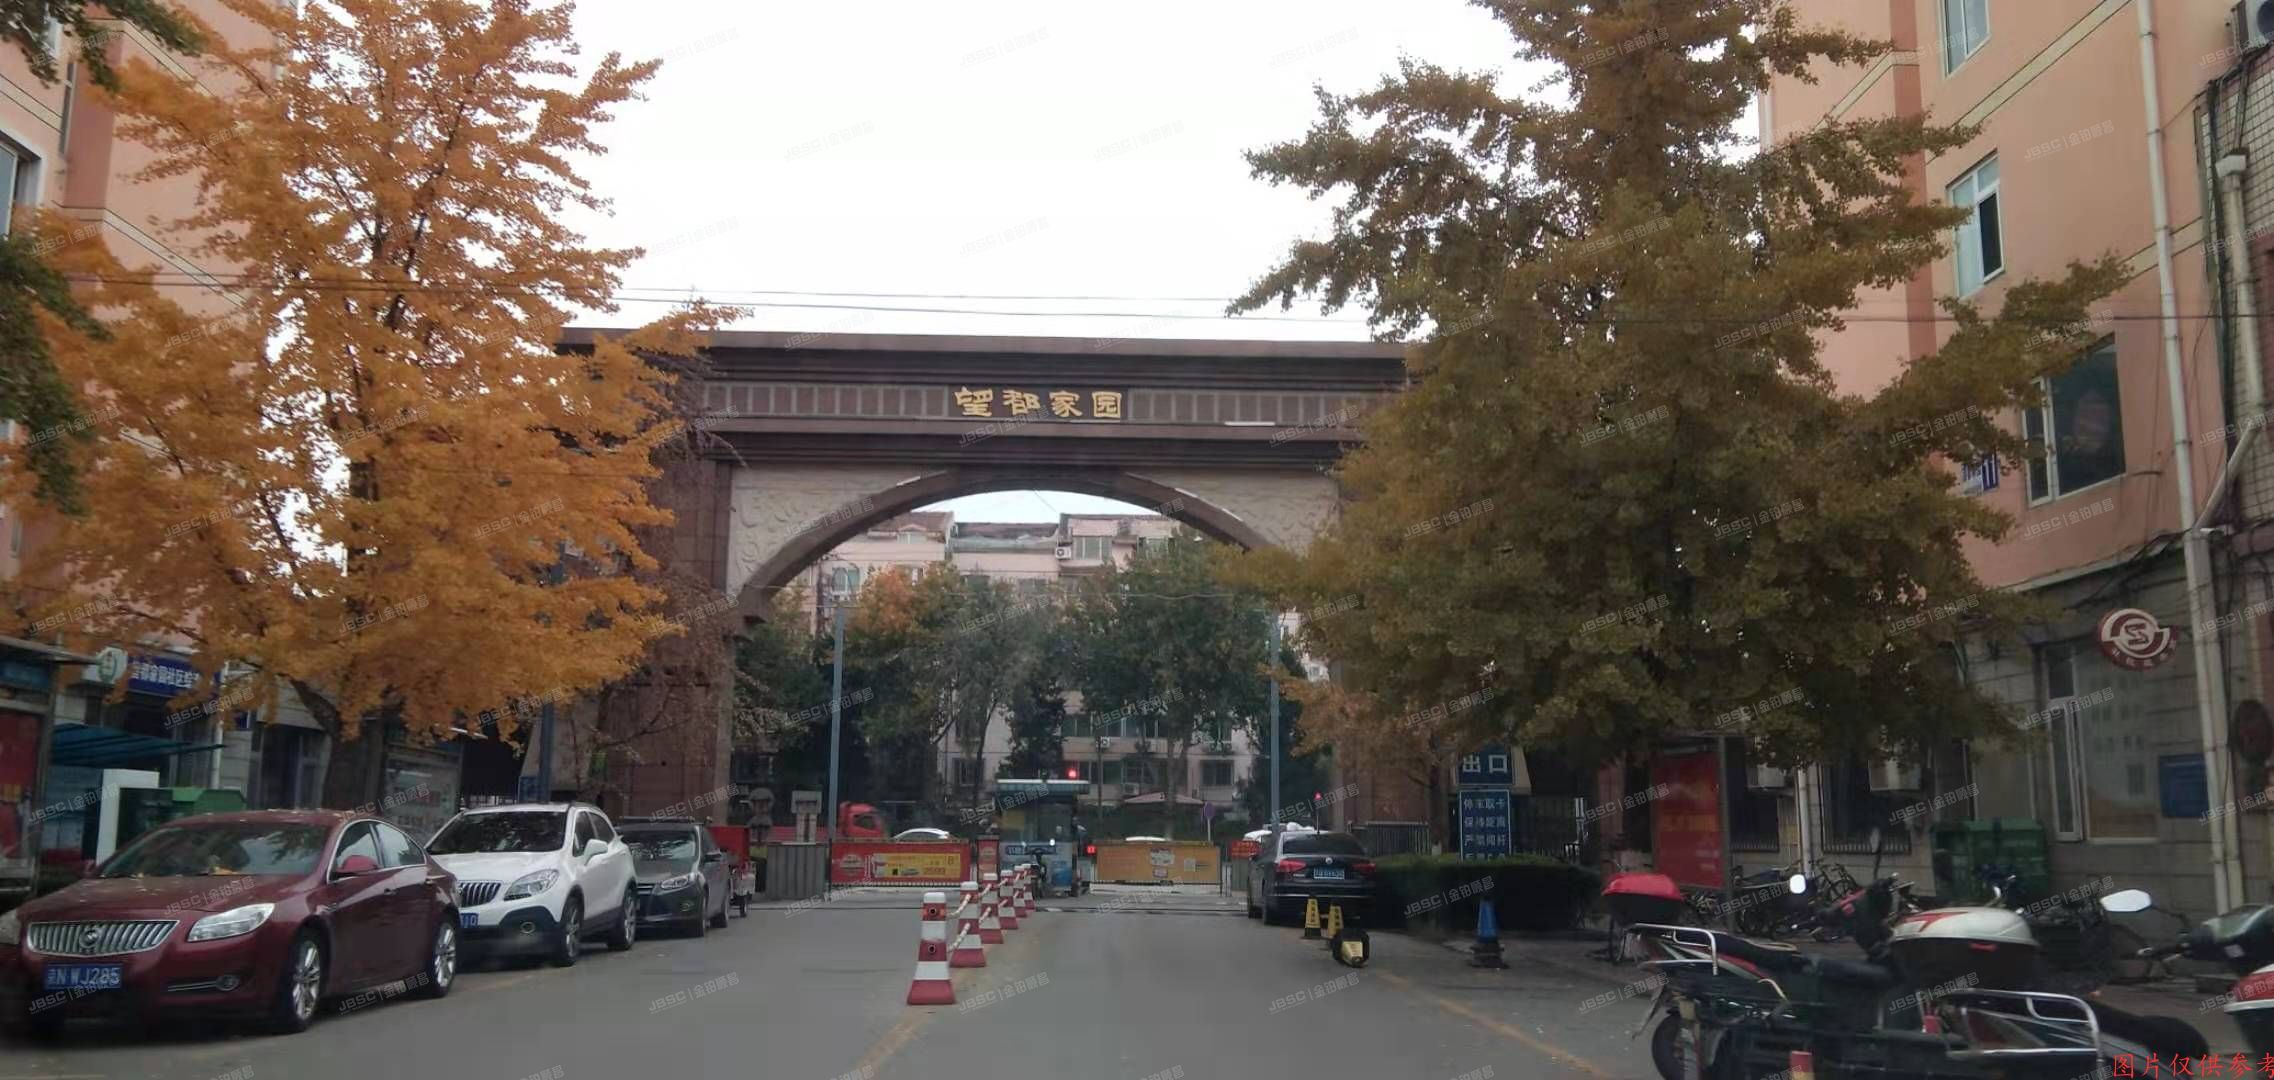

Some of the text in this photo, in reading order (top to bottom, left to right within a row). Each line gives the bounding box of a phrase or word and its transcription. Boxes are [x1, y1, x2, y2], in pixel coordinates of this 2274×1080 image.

[954, 386, 1122, 418] 望都家园
[1463, 753, 1508, 773] 出口
